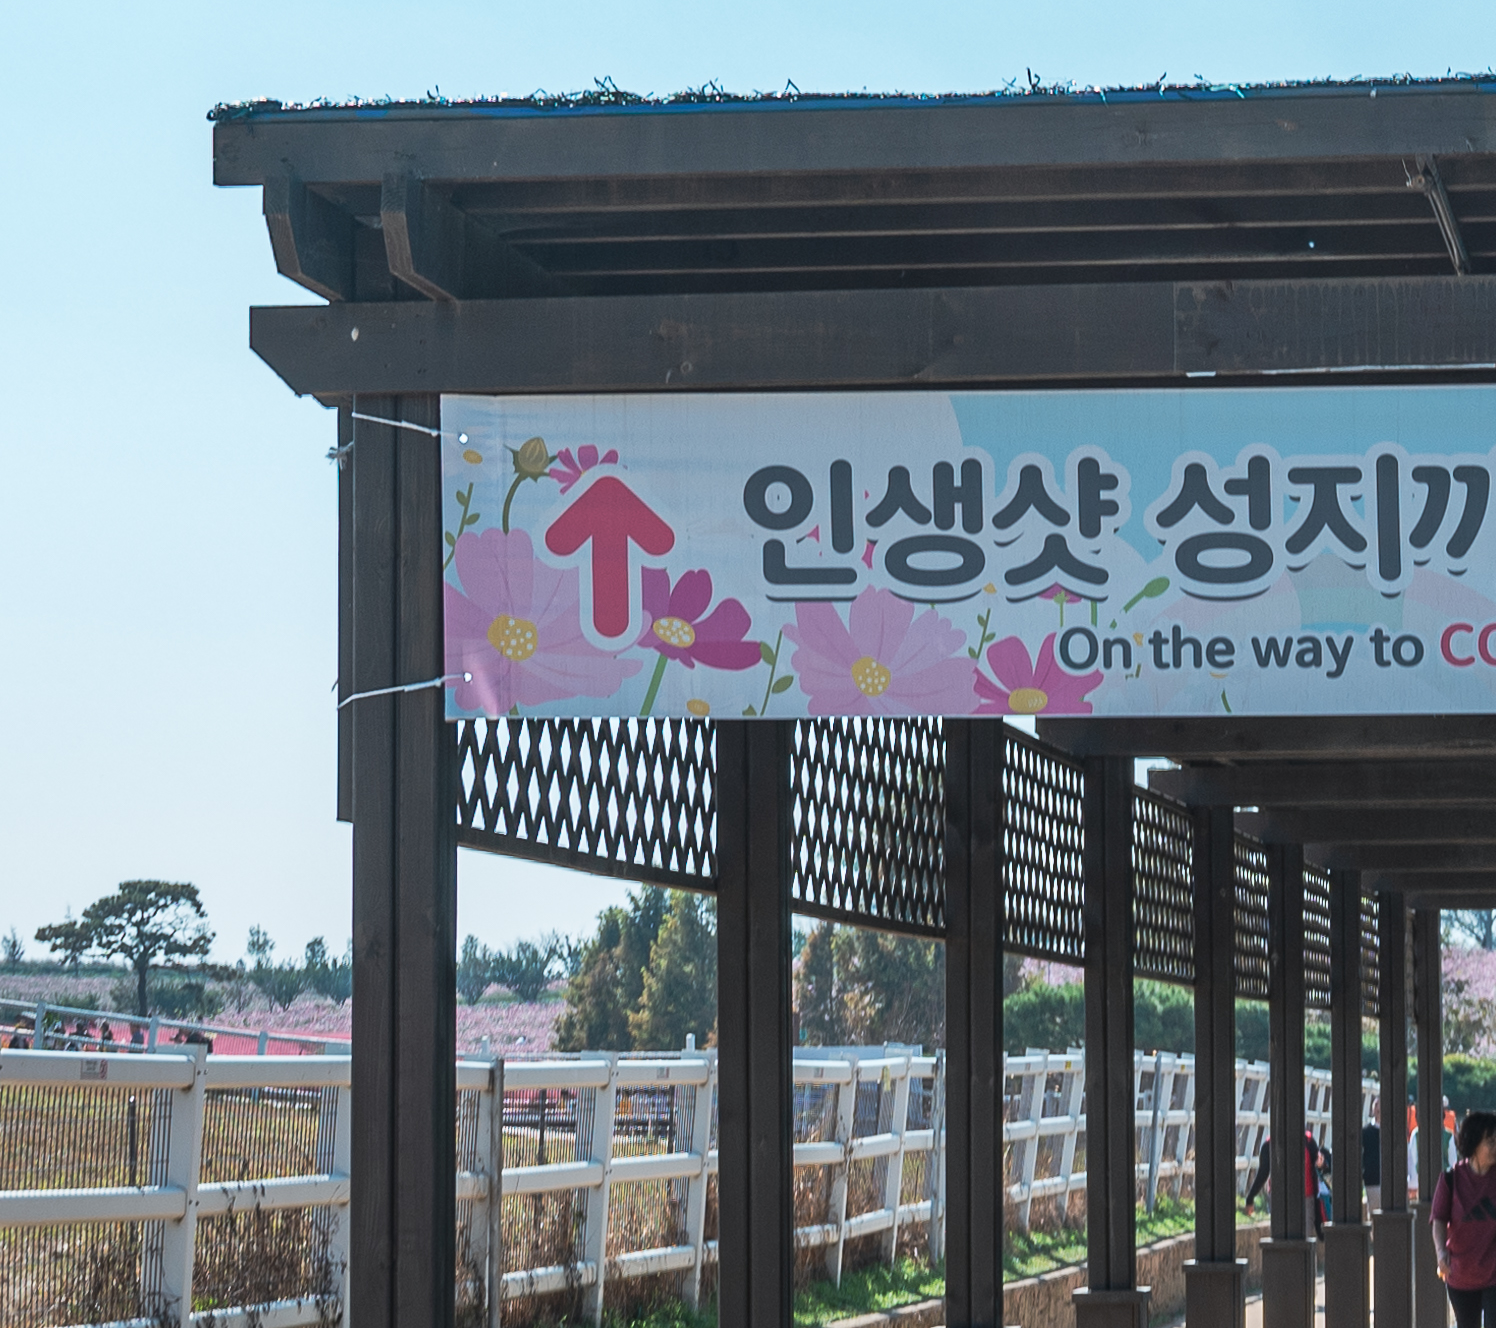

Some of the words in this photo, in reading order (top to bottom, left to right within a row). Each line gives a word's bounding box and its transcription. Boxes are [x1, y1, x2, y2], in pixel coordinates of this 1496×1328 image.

[743, 457, 1119, 585] 인생샷
[1059, 626, 1132, 670] On
[1149, 625, 1235, 669] the
[1251, 635, 1354, 679] way
[1370, 628, 1424, 669] to
